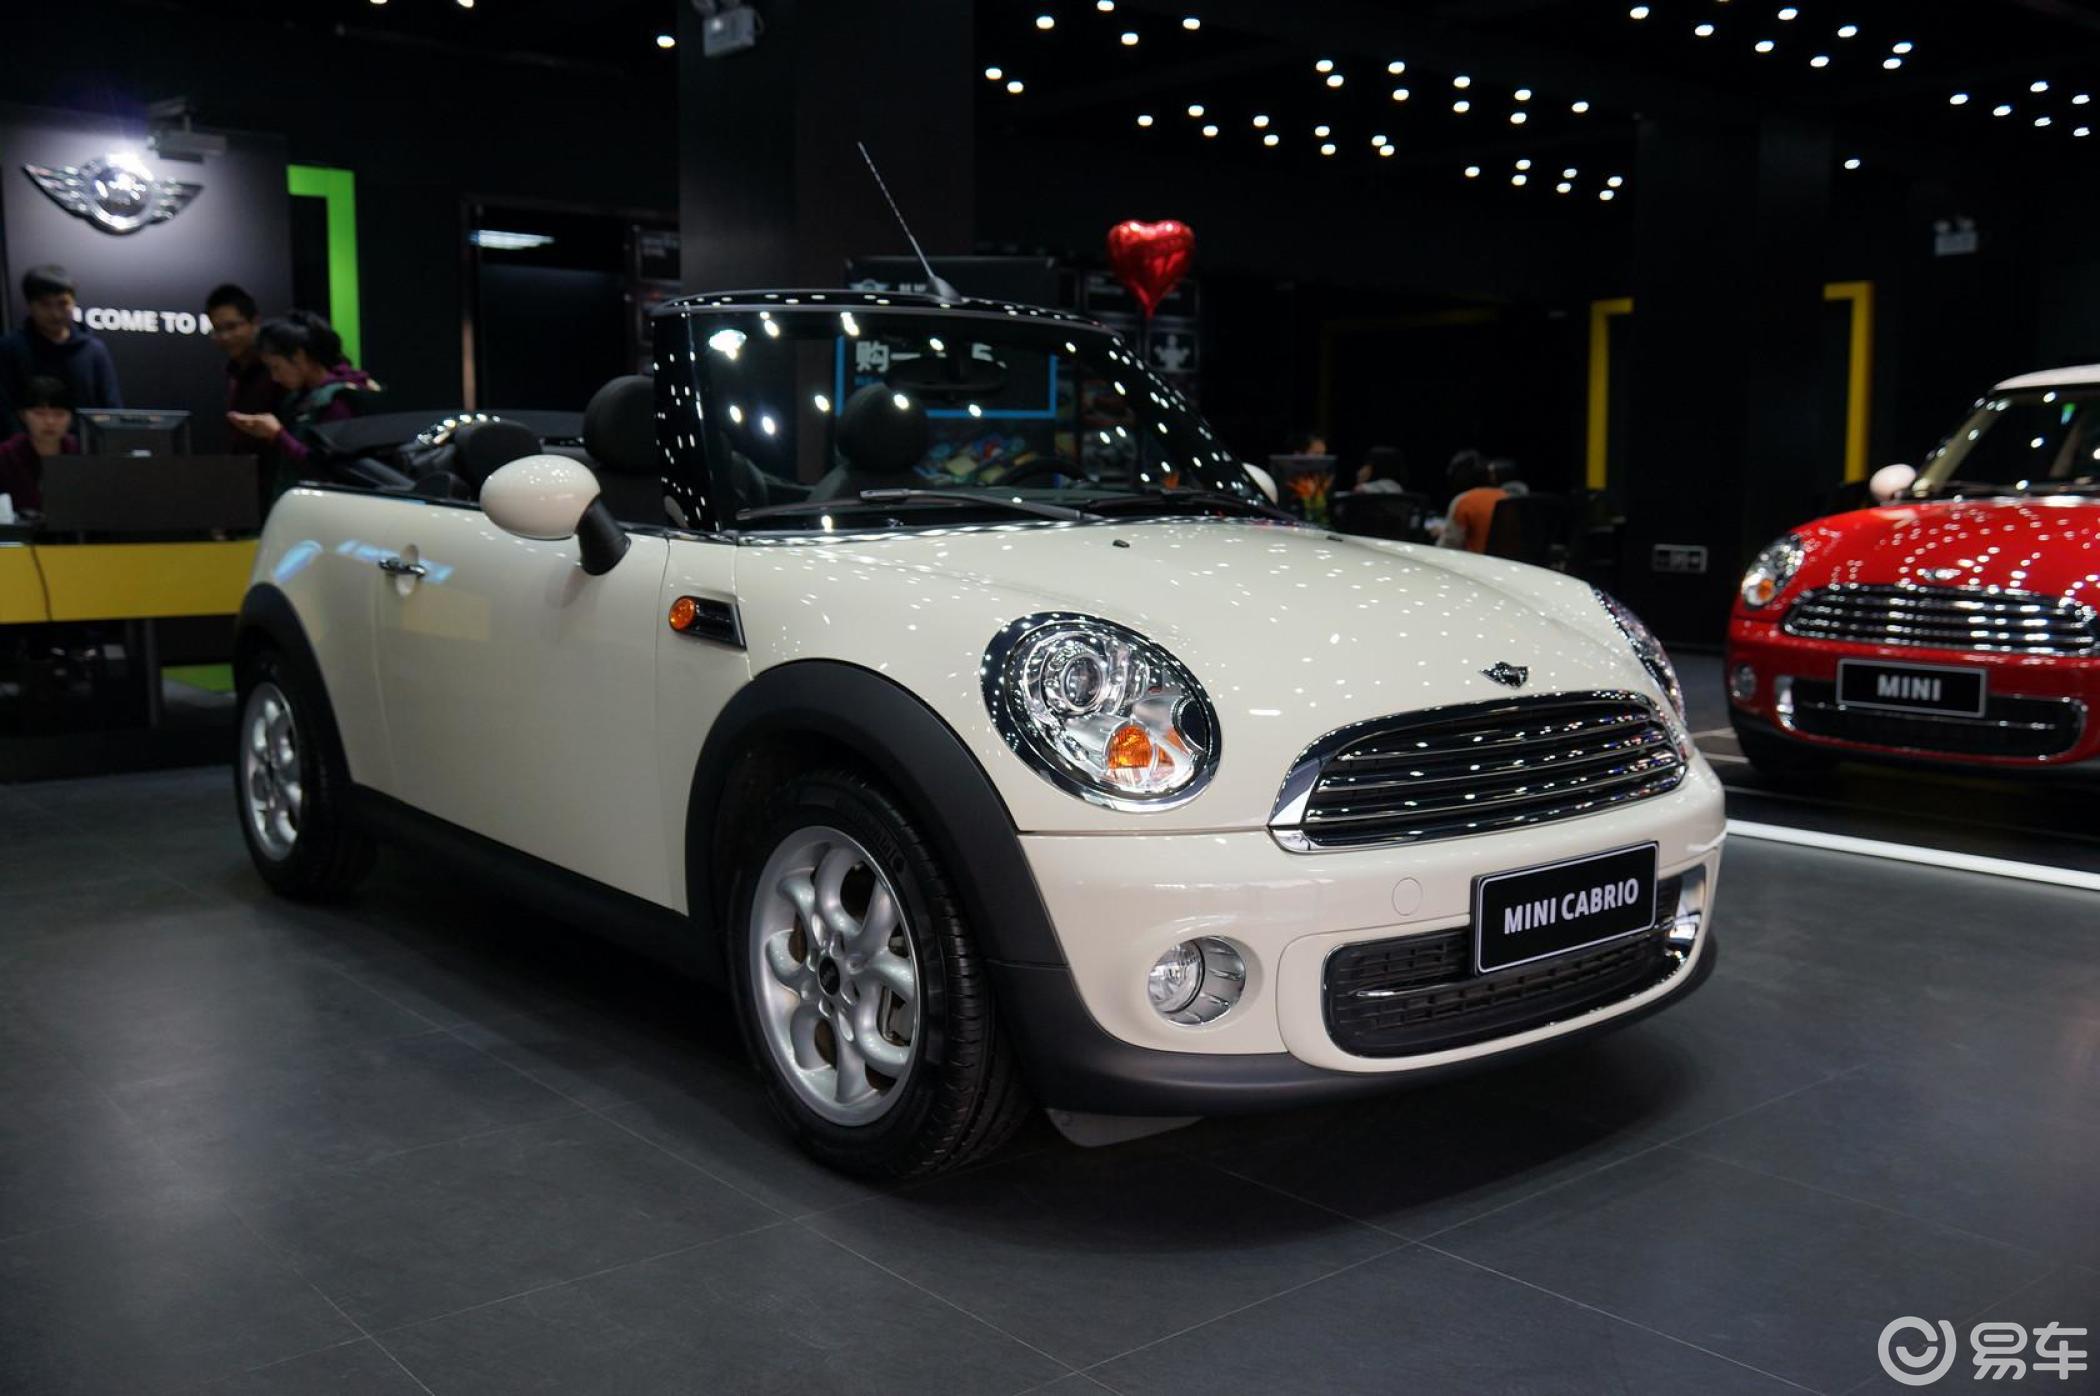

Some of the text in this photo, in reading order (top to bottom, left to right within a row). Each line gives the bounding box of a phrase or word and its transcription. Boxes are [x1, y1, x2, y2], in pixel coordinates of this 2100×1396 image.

[73, 307, 159, 332] COME
[160, 311, 196, 334] TO
[1877, 674, 1941, 702] MINI
[1504, 878, 1639, 935] MINI CABRIO
